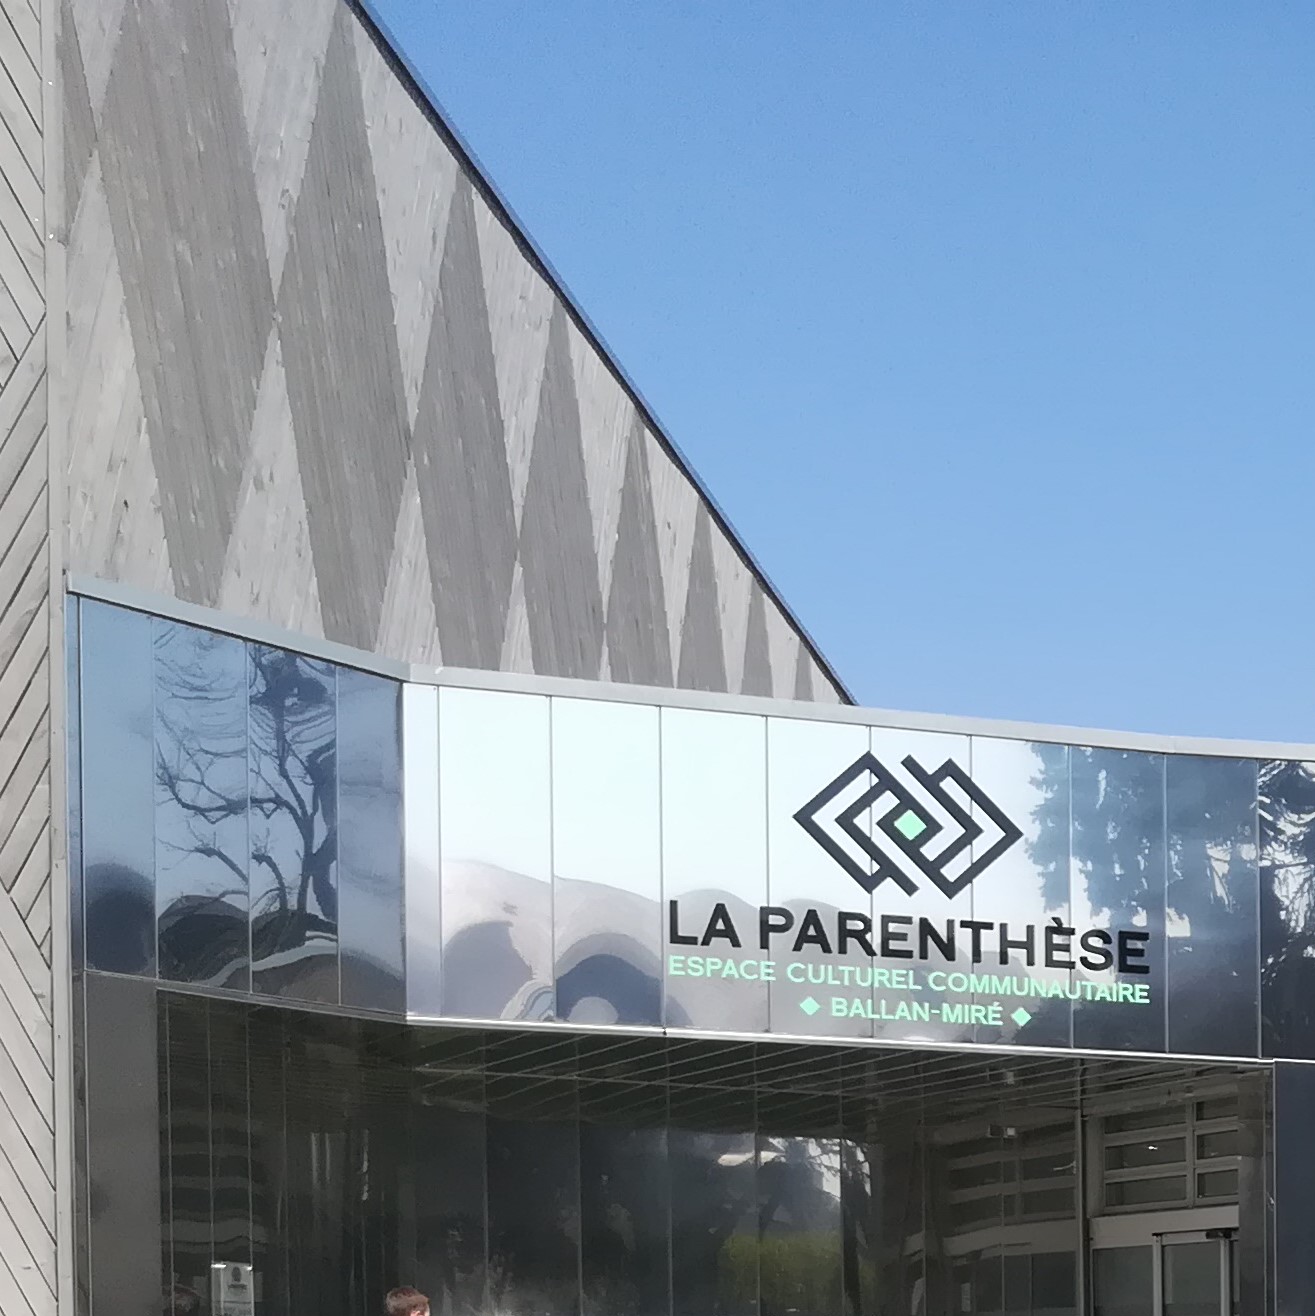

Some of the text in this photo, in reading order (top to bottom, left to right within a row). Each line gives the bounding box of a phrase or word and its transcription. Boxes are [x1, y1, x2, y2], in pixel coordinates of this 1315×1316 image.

[668, 899, 1151, 975] LA PARENTHÈSE
[668, 955, 1151, 1004] ESPACE CULTUREL COMMUNAUTAIRE
[831, 996, 1004, 1026] BALLAN-MIRÉ
